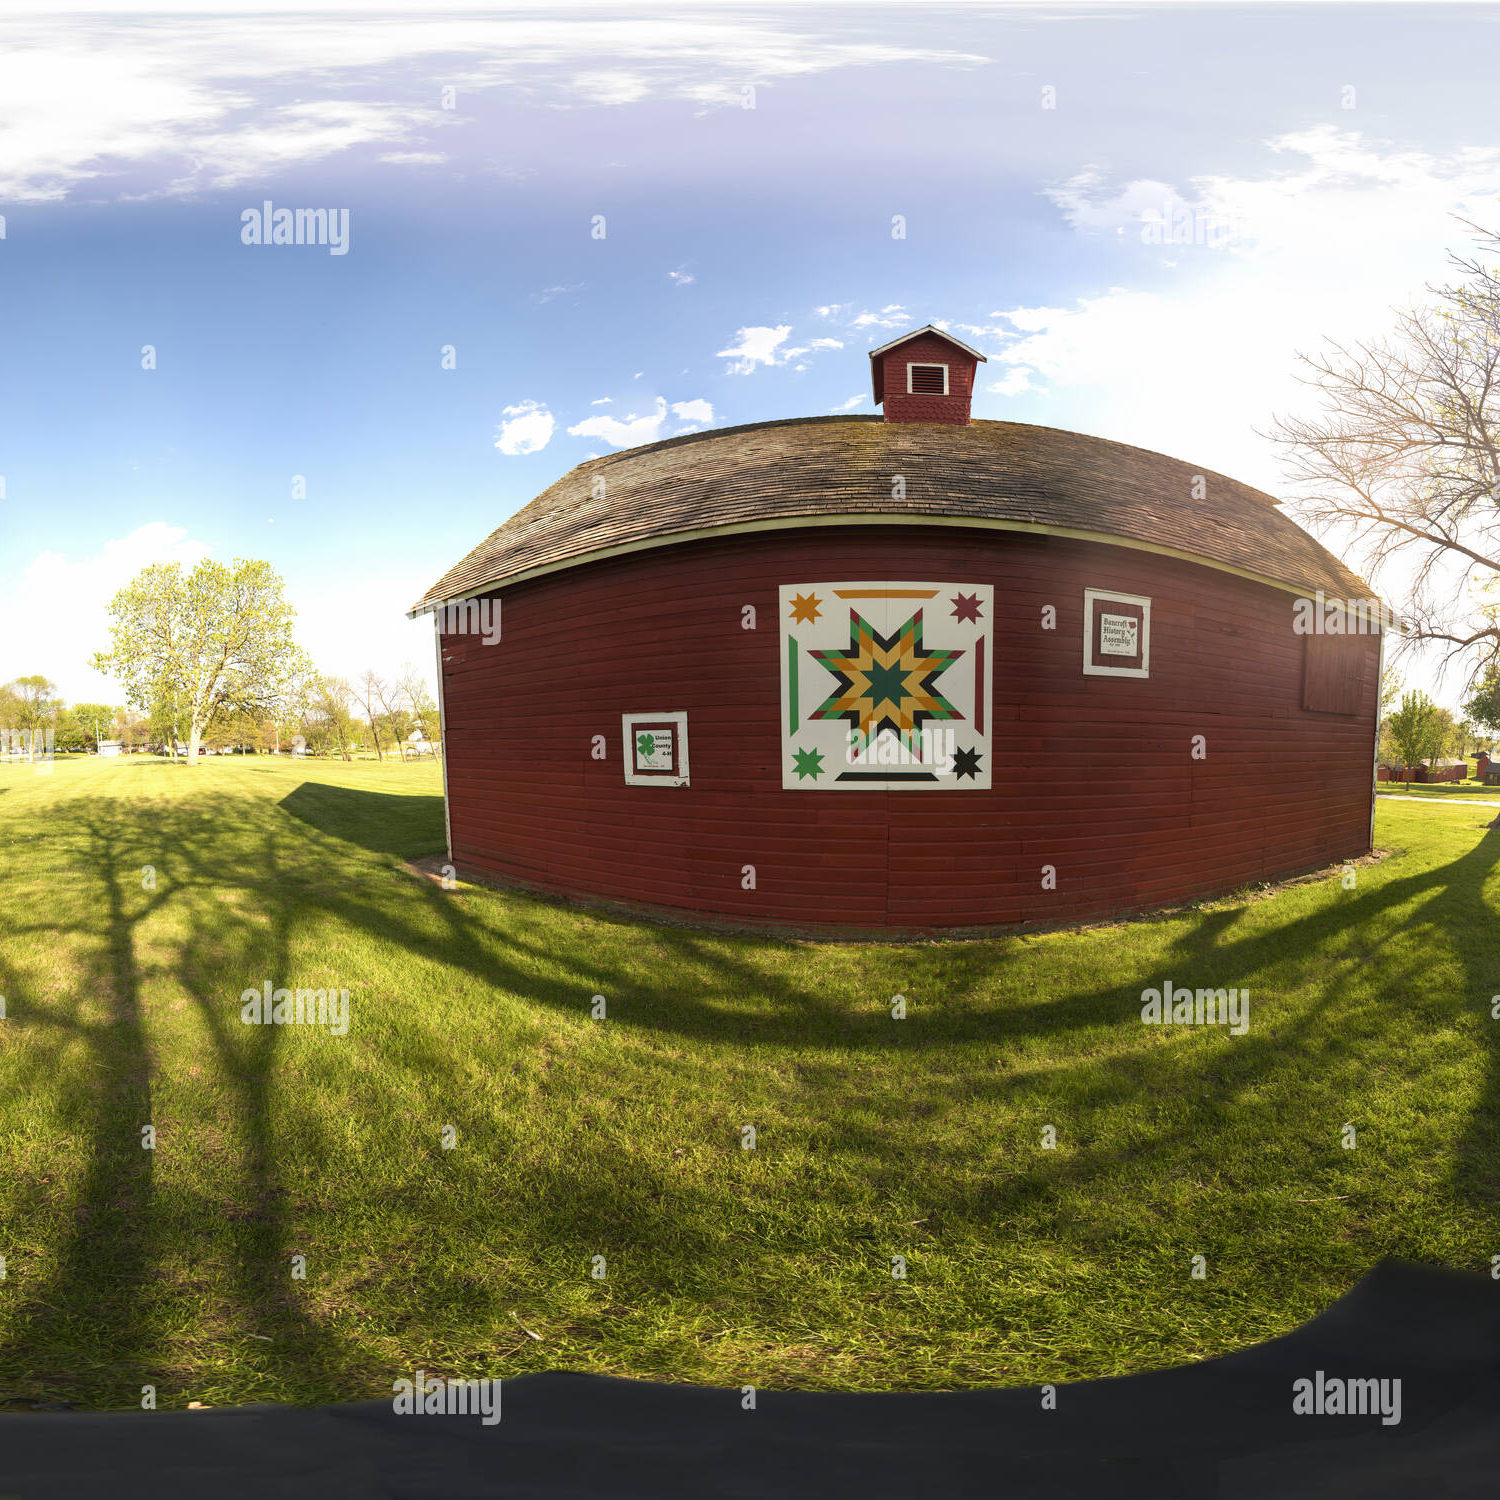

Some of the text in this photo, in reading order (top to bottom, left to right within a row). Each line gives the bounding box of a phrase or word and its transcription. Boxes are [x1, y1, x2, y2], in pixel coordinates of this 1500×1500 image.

[1103, 618, 1127, 628] Bancroft
[1103, 627, 1125, 635] History
[1103, 635, 1131, 646] Assembly
